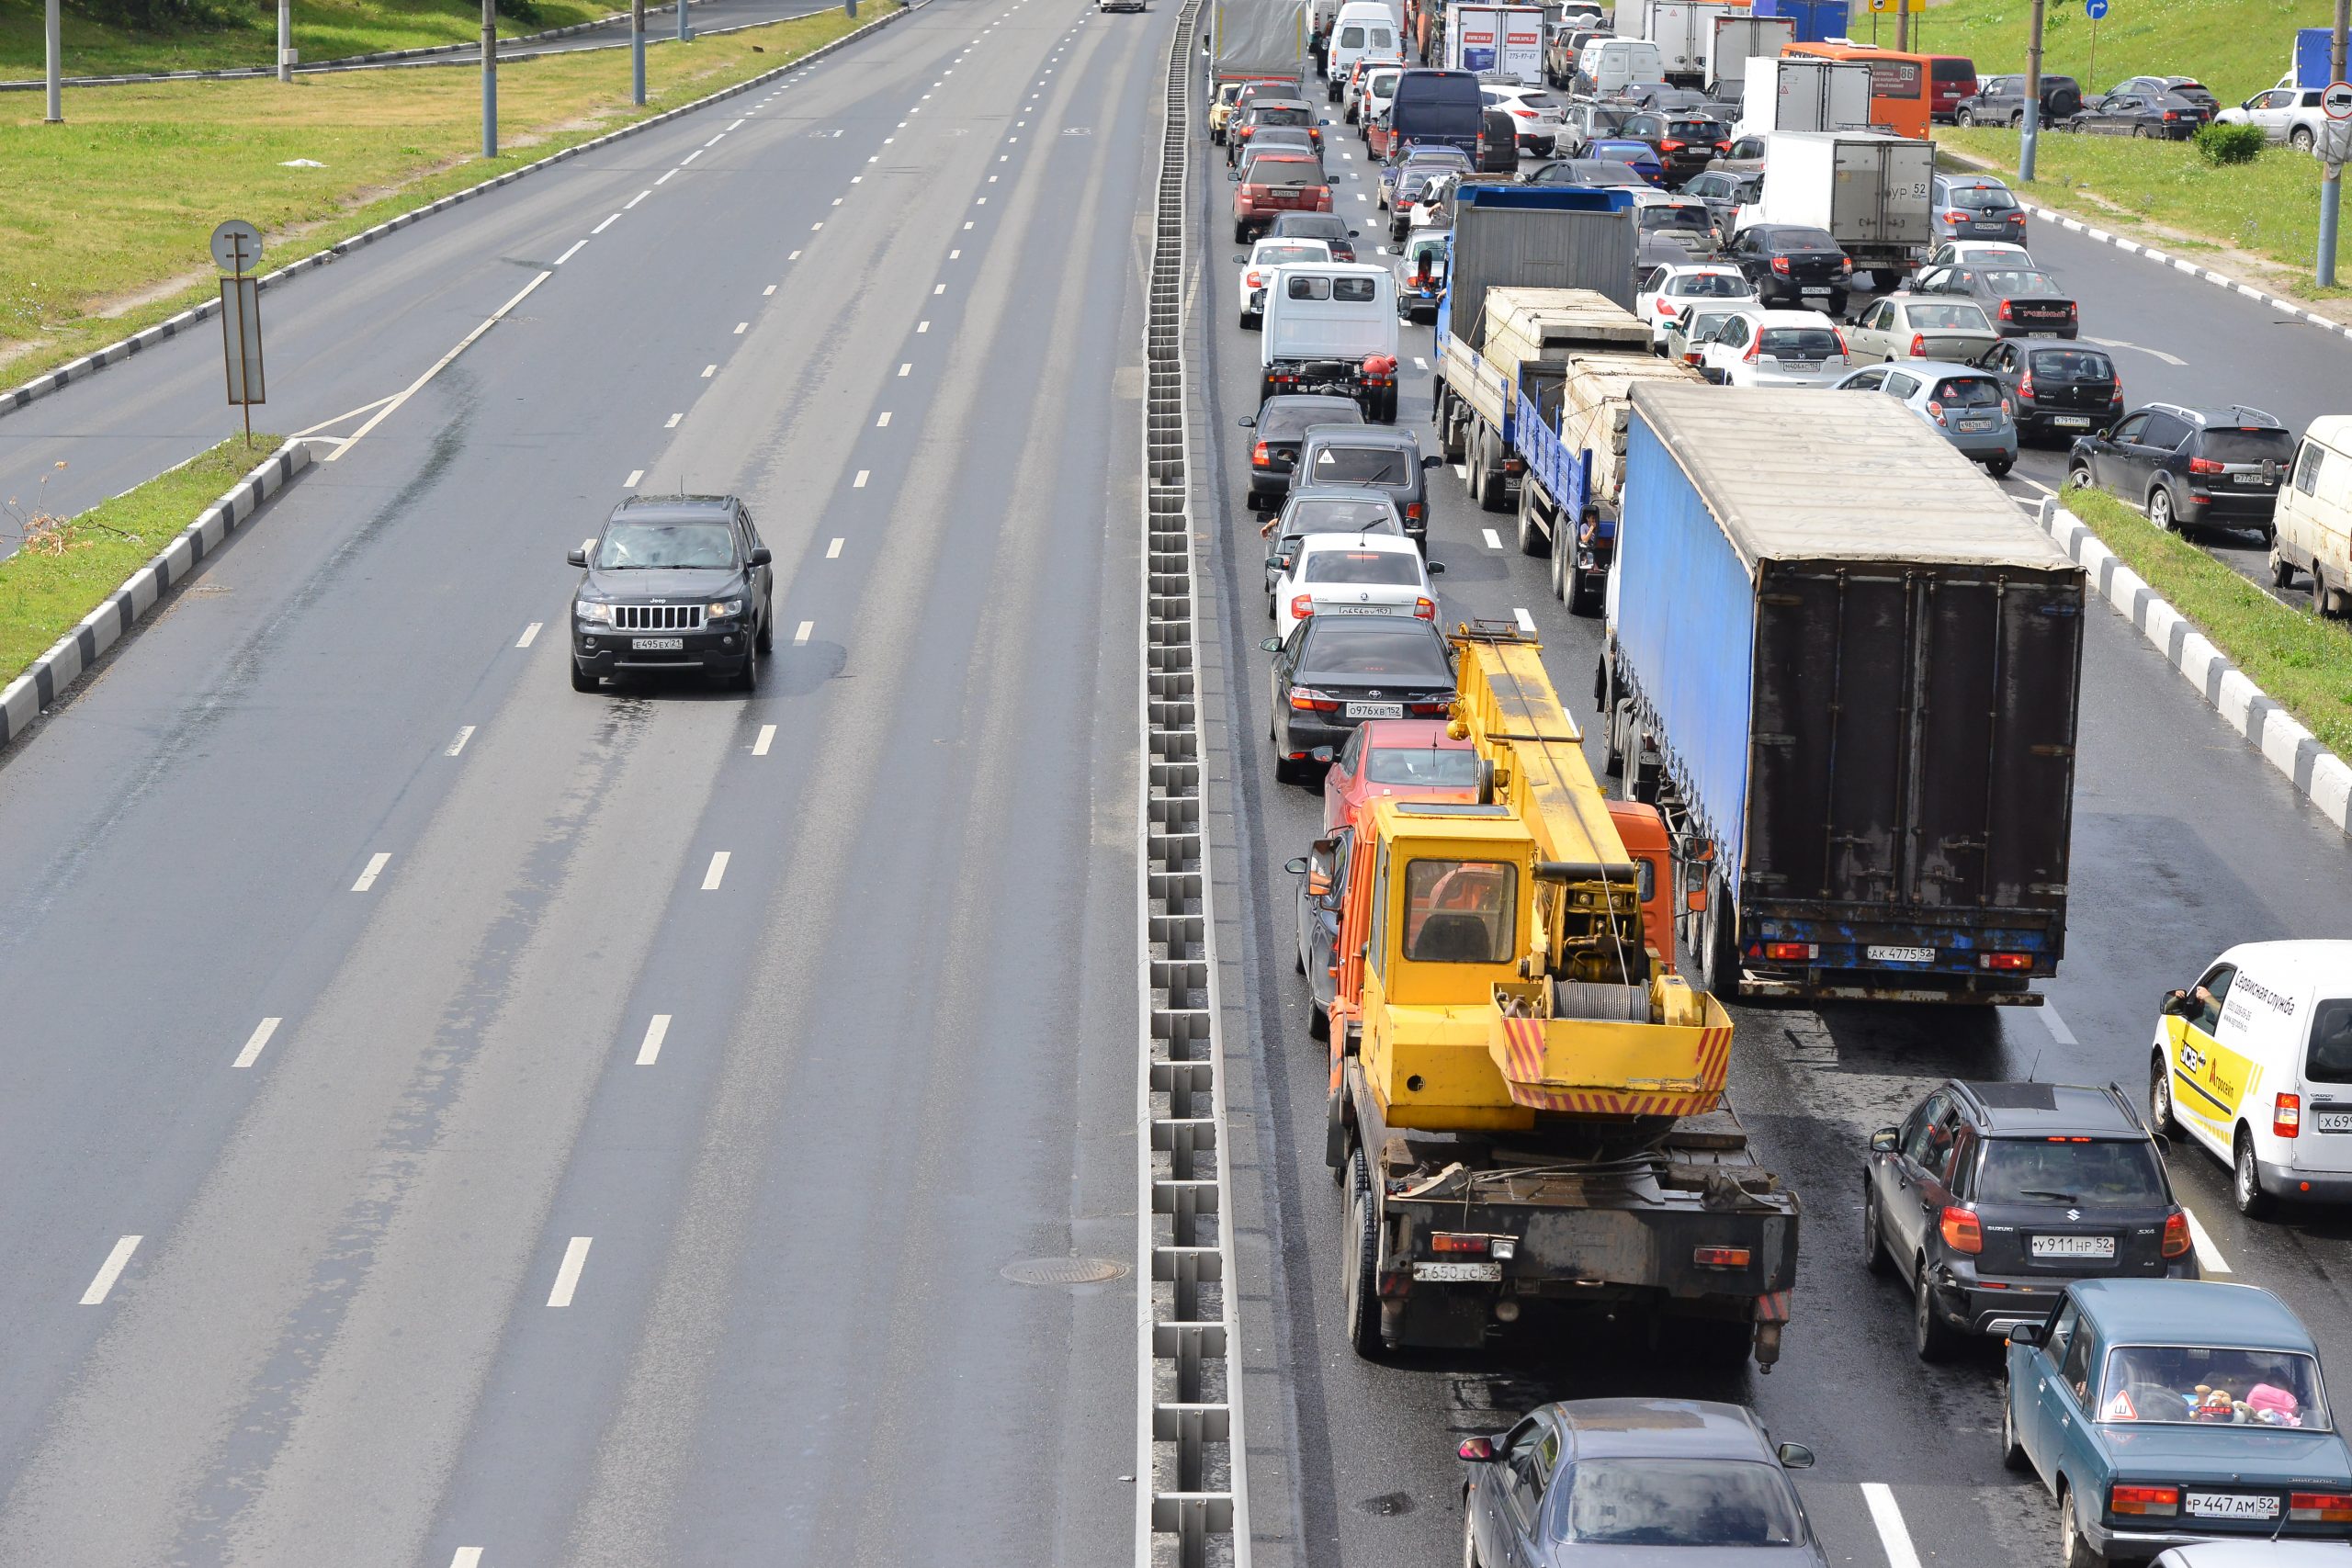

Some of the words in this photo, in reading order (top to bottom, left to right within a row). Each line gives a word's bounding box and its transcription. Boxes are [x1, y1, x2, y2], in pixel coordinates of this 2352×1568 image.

[1901, 67, 1913, 79] 86
[1914, 183, 1926, 194] 52
[1889, 948, 1917, 960] 4775
[1919, 948, 1931, 957] 52
[2235, 970, 2268, 1001] Сервисная
[2267, 992, 2295, 1016] служба
[2180, 1040, 2198, 1074] JCB
[2096, 1237, 2109, 1248] 52
[2115, 1404, 2127, 1414] Ш
[2258, 1498, 2274, 1509] 52
